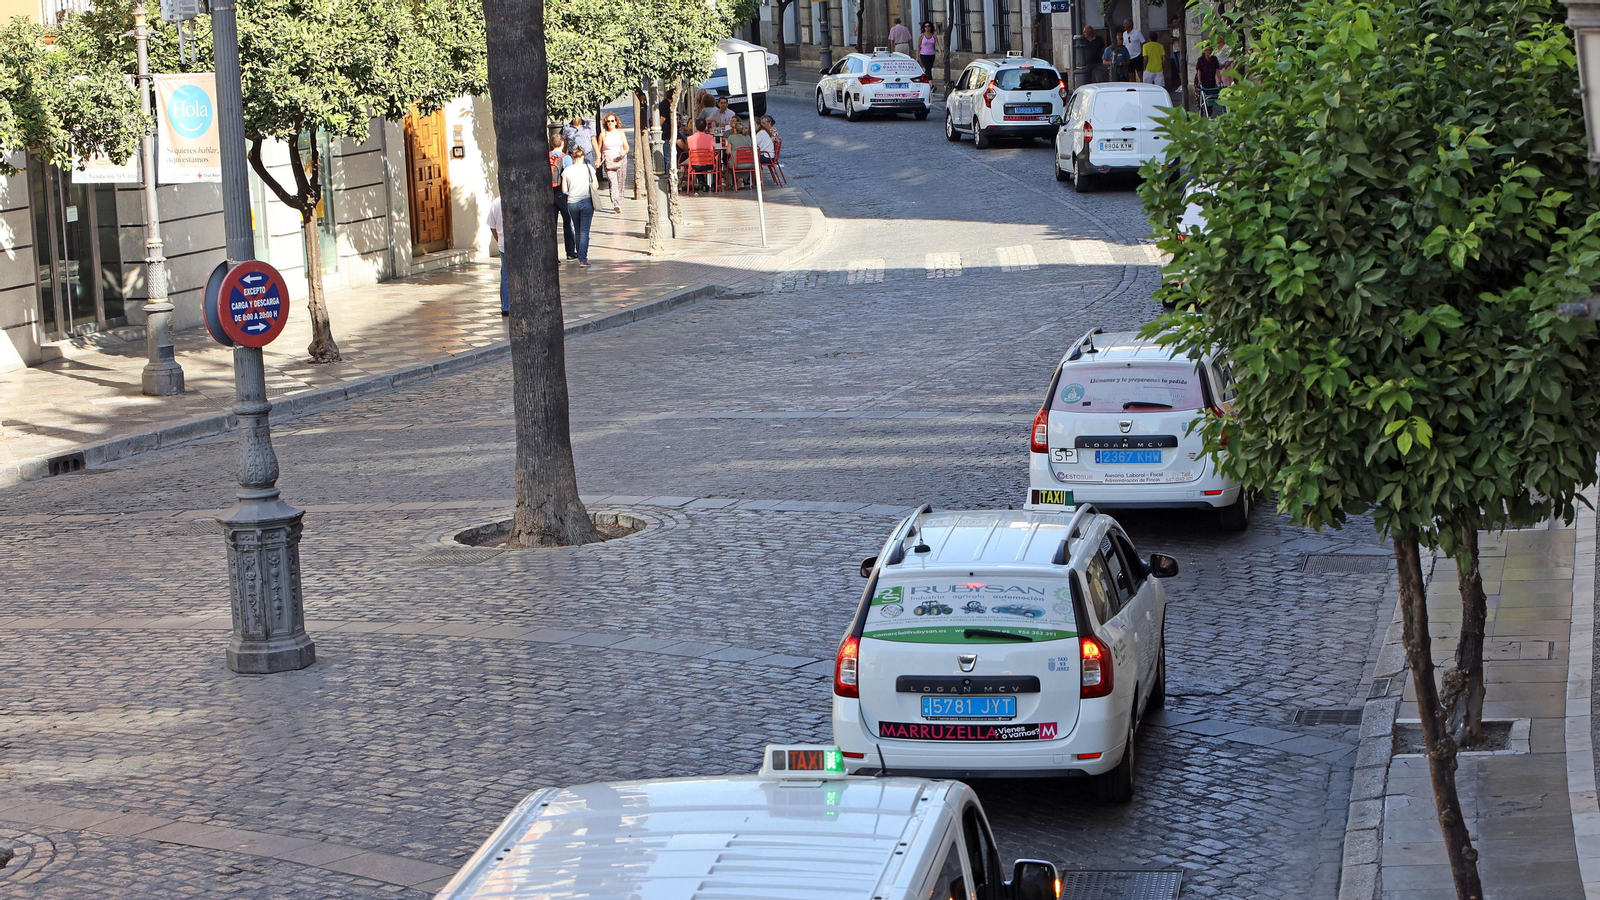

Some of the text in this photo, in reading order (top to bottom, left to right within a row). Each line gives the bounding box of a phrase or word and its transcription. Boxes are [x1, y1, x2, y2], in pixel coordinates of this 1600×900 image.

[172, 99, 209, 118] Hola
[174, 147, 197, 155] quieres
[198, 146, 220, 154] hablar,
[243, 286, 266, 296] EXCEPTO
[231, 301, 249, 311] CARGA
[254, 297, 280, 307] DESCARGA
[259, 311, 272, 319] 20:00
[1054, 450, 1074, 461] SP
[1103, 451, 1133, 463] 2367
[1137, 451, 1160, 463] KHW
[1041, 490, 1063, 504] TAXI
[910, 584, 1046, 595] RUBYSAN
[872, 629, 947, 638] comercial@rubysan.es
[933, 699, 972, 714] 5781
[980, 698, 1012, 714] JYT
[881, 723, 998, 739] MARRUZELLA
[1008, 728, 1040, 739] vamos?
[1042, 727, 1055, 737] M
[789, 751, 823, 770] TAXI
